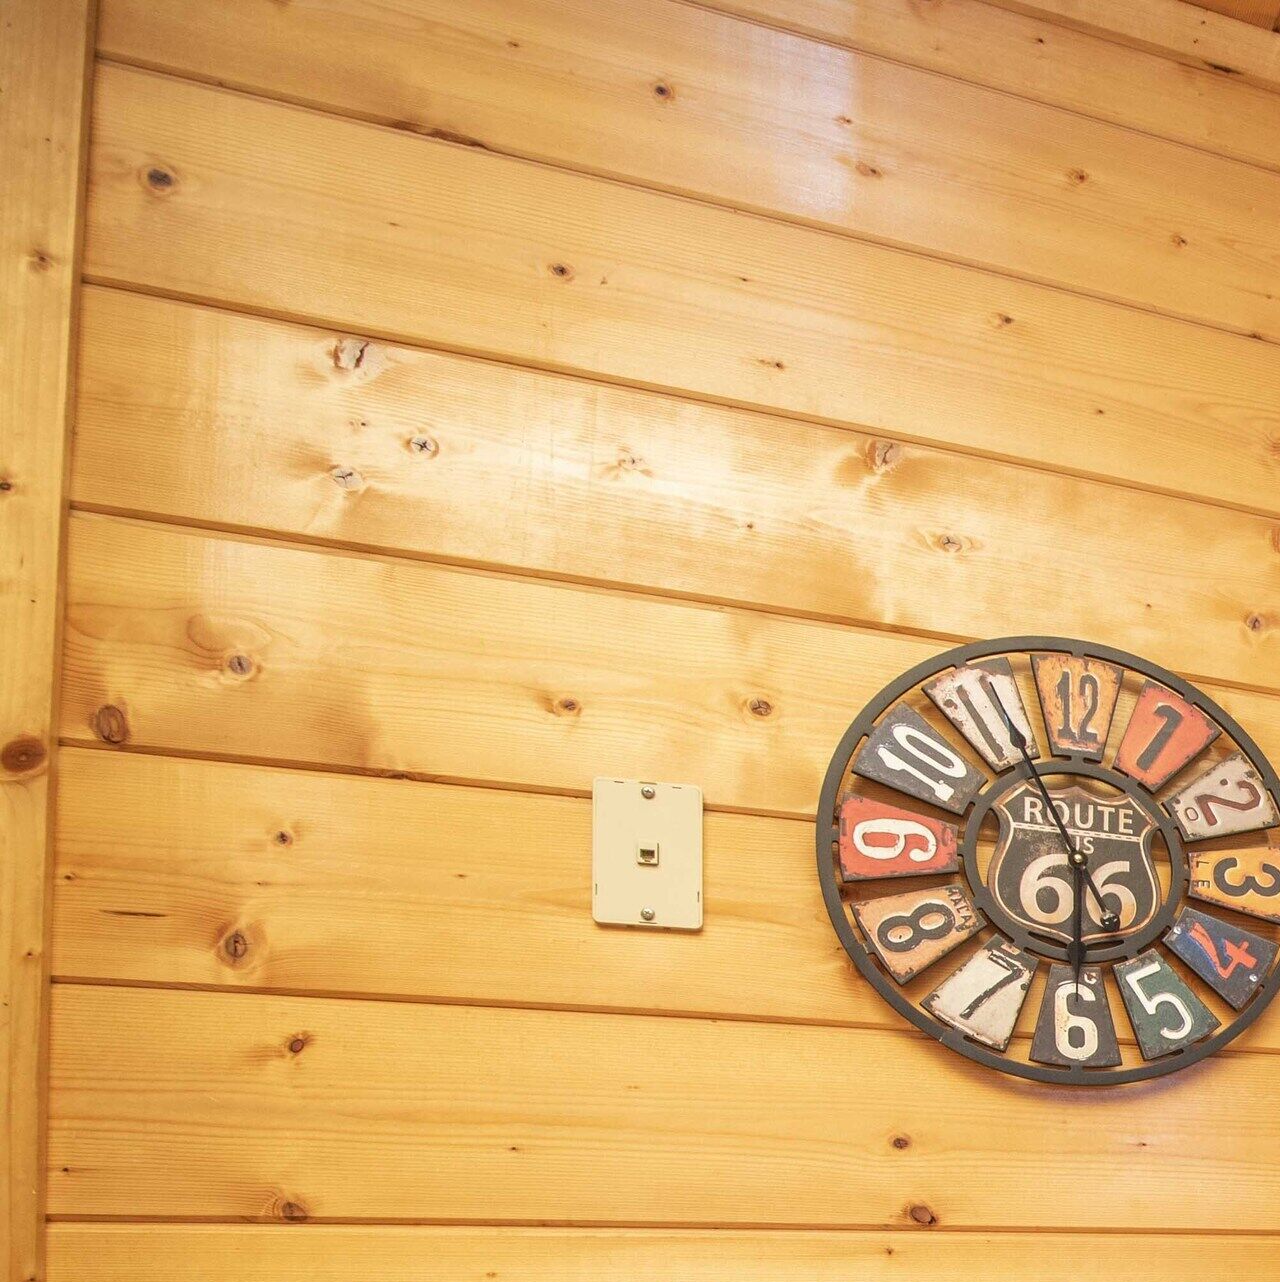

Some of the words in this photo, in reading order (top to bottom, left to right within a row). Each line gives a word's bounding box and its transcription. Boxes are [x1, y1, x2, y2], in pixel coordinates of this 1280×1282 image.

[1055, 670, 1100, 742] 12
[1136, 704, 1185, 770] 1
[877, 724, 968, 802] 10
[1023, 796, 1135, 835] ROUTE
[1194, 779, 1261, 827] 2
[852, 817, 938, 863] 9
[1019, 852, 1138, 930] 66
[876, 901, 957, 953] 8
[1188, 921, 1258, 980] 4
[959, 949, 1026, 1021] 7
[1125, 961, 1194, 1040] 5
[1054, 980, 1099, 1061] 6
